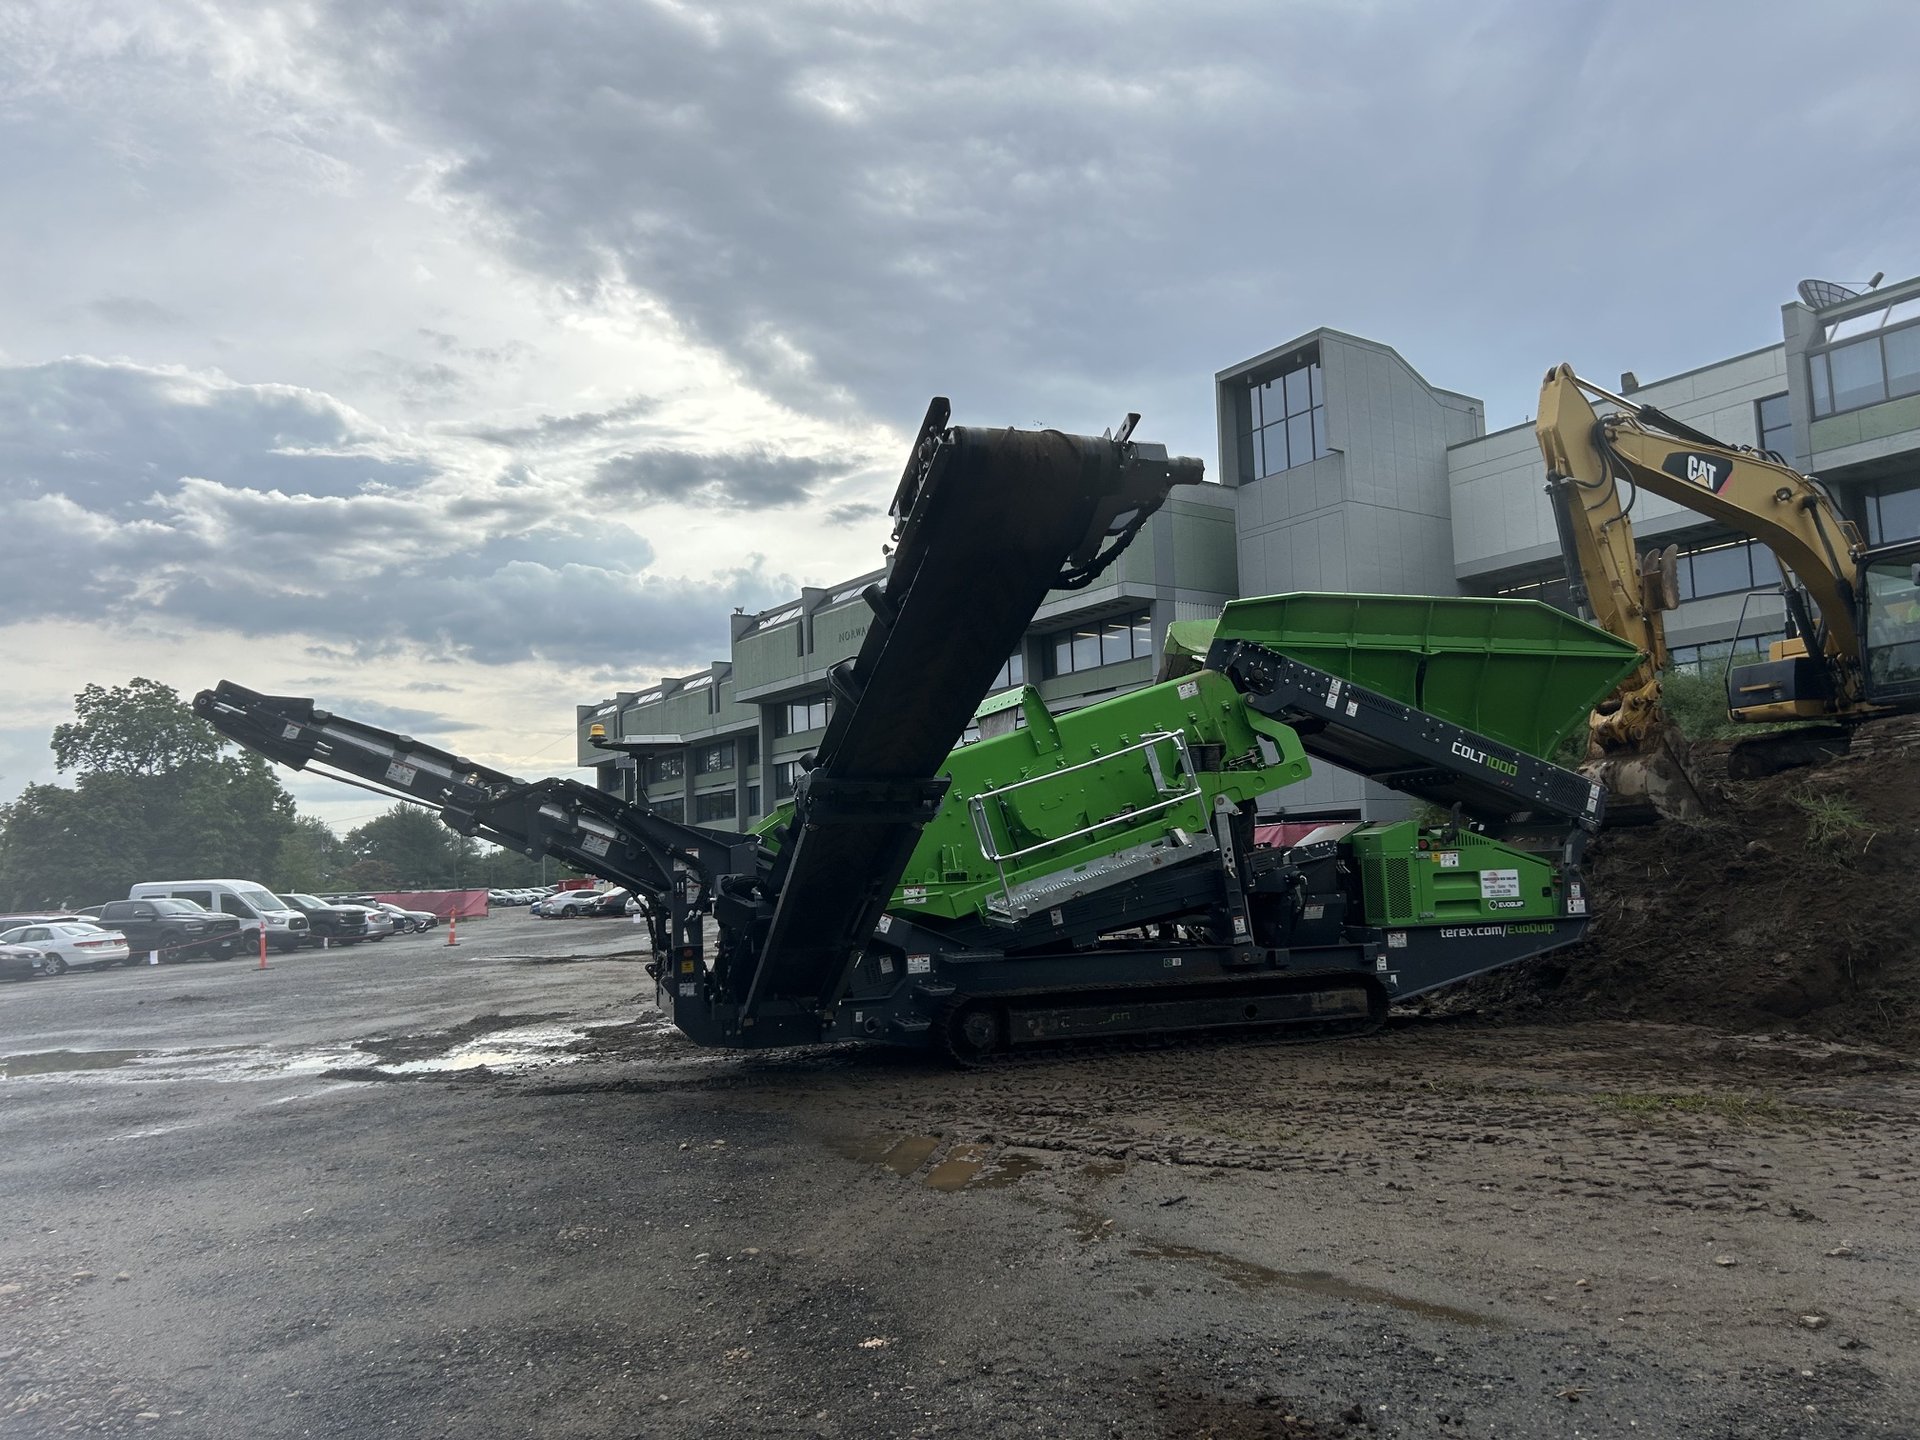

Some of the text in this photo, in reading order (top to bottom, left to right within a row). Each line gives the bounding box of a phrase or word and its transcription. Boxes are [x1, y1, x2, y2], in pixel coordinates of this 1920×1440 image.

[1686, 455, 1717, 490] CAT
[838, 625, 870, 643] NORWA
[1451, 741, 1518, 776] COLT1000
